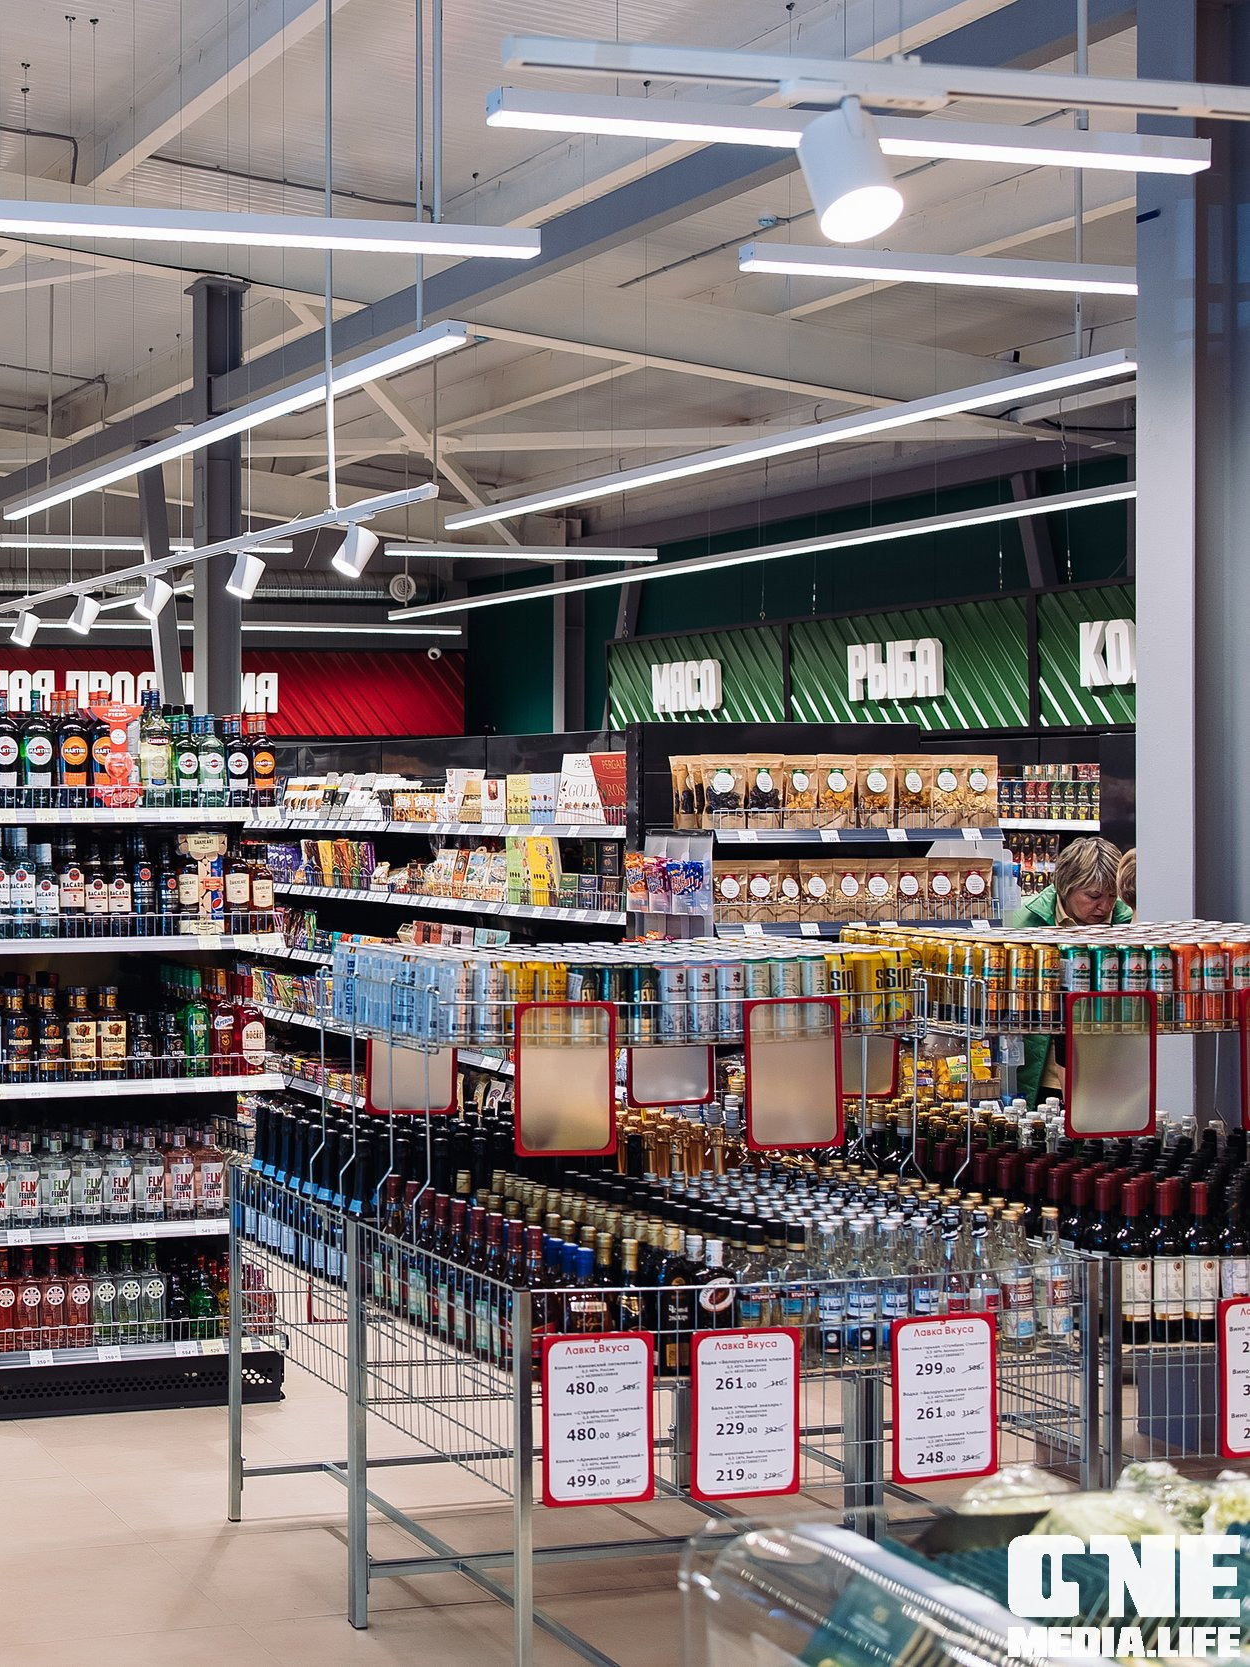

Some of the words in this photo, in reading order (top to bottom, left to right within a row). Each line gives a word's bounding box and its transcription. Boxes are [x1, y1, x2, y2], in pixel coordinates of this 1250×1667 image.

[1079, 618, 1136, 688] КО
[847, 638, 944, 702] РЫБА
[651, 658, 722, 713] МЯСО
[568, 783, 598, 798] GOLD
[605, 783, 626, 797] ROS
[886, 963, 910, 990] sip
[913, 1328, 943, 1337] Лавка
[944, 1326, 974, 1336] Вкуса
[565, 1346, 596, 1356] Лавка
[598, 1343, 630, 1354] Вкуса
[714, 1342, 745, 1351] Лавка
[746, 1340, 778, 1350] Вкуса
